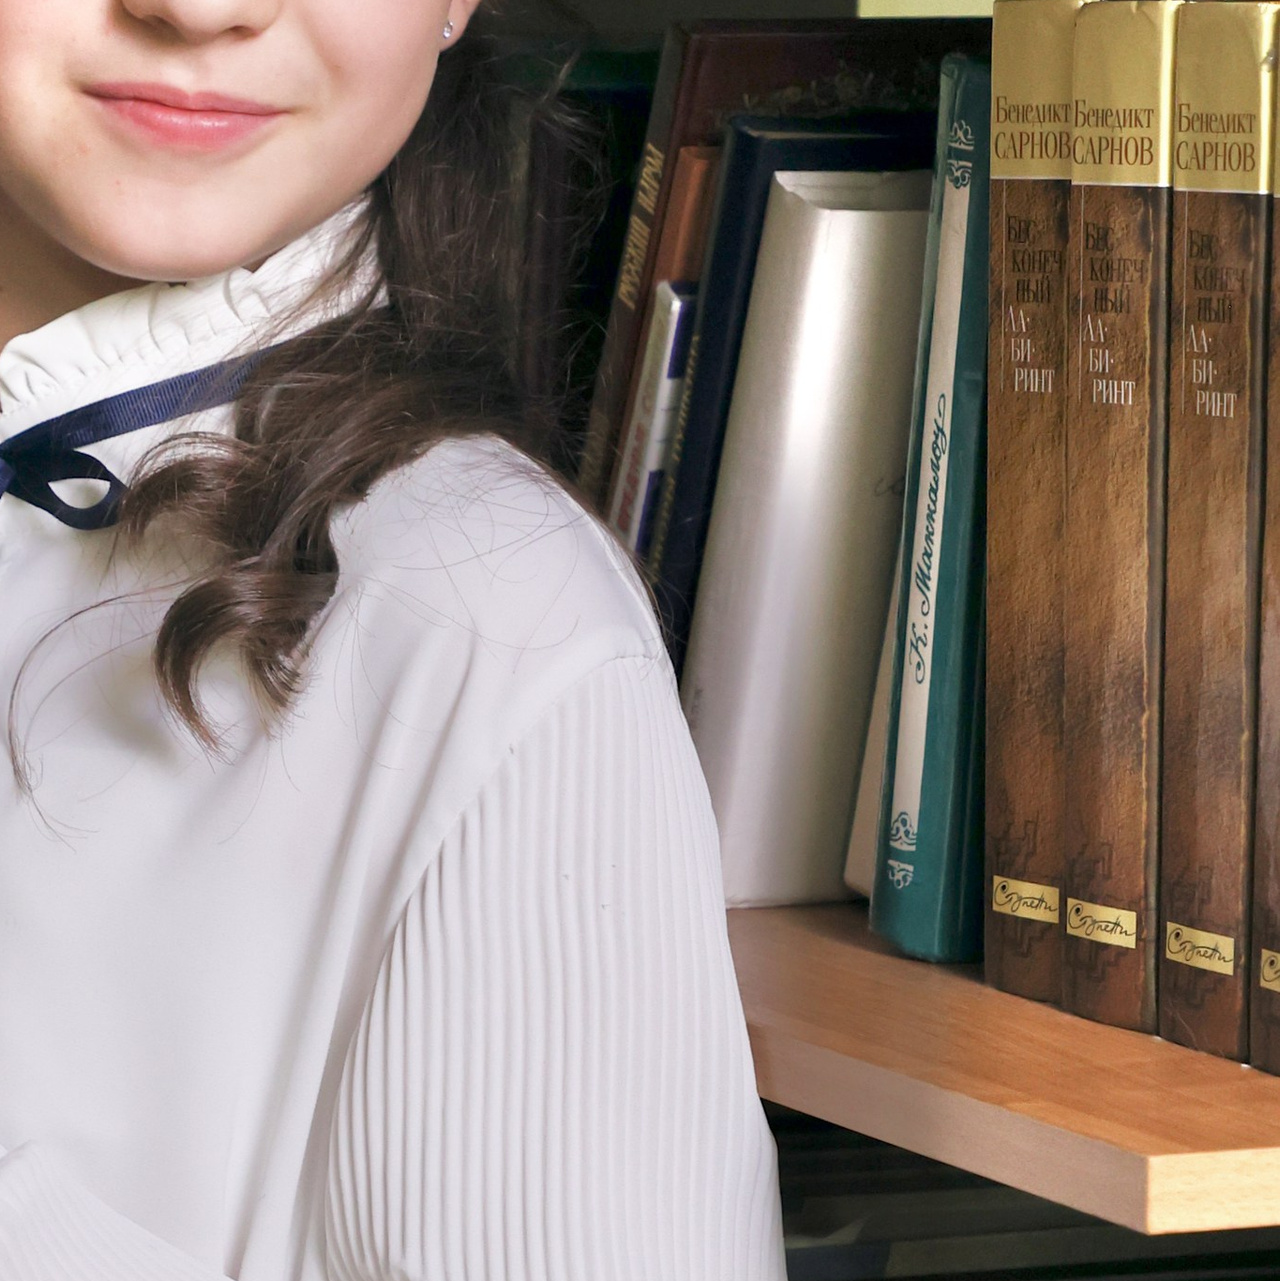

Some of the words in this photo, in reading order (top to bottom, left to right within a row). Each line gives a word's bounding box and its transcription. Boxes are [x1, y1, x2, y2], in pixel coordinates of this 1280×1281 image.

[996, 96, 1070, 129] Бенедикт
[1074, 99, 1154, 132] Бенедикт
[1178, 103, 1256, 137] Бенедикт
[994, 131, 1070, 160] САРНОВ
[1073, 136, 1154, 166] САРНОВ
[1176, 140, 1256, 172] САРНОВ
[1014, 368, 1055, 393] РИНТ
[1092, 378, 1136, 406] РИНТ
[1196, 390, 1238, 418] РИНТ
[914, 393, 947, 617] Маккалоу
